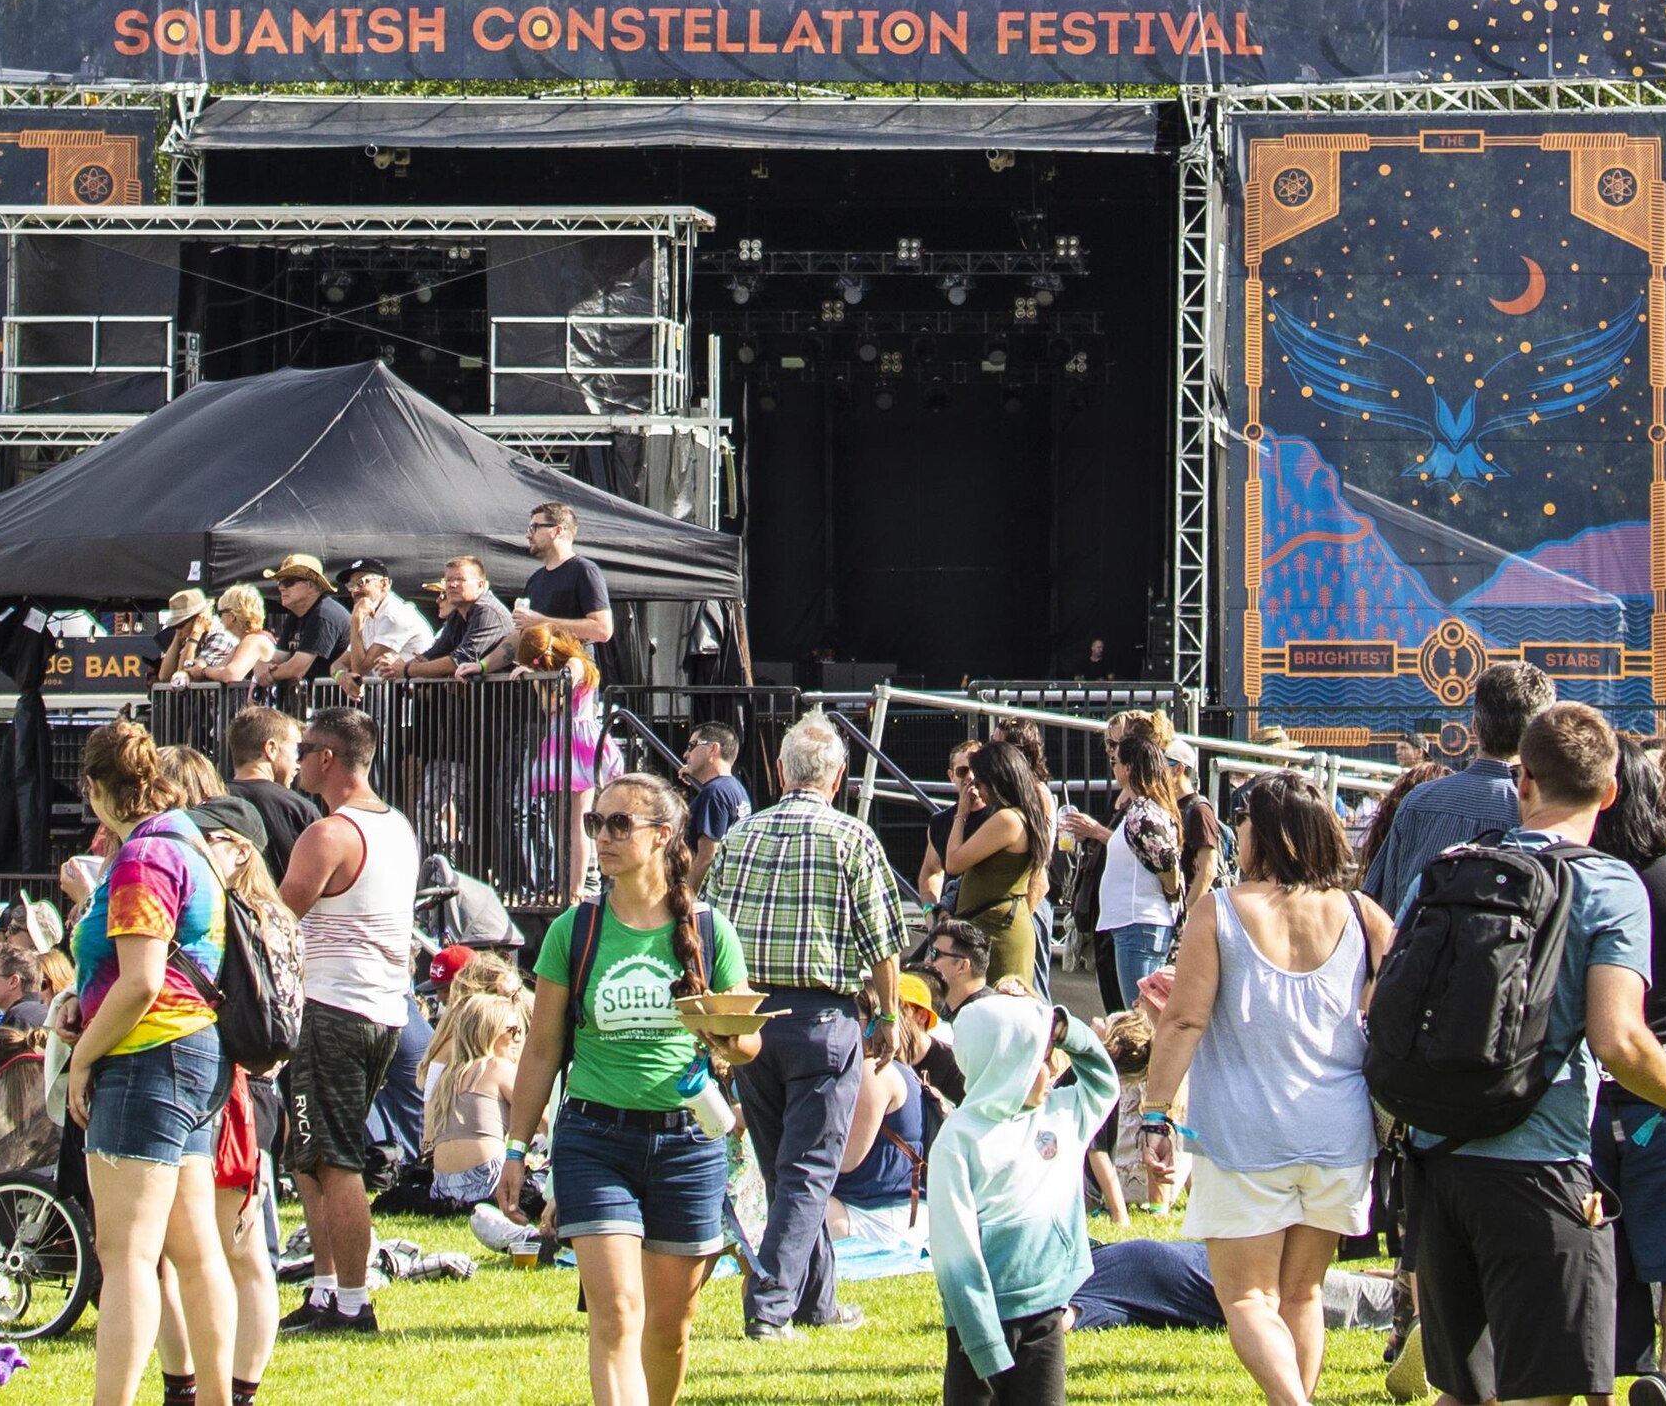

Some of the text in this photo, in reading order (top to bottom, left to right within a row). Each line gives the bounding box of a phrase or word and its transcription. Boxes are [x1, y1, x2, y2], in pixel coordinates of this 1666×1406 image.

[113, 6, 1263, 56] SQUAMISH CONSTELLATION FESTIVAL
[1439, 135, 1466, 147] THE
[85, 655, 141, 678] BAR
[1293, 651, 1390, 665] BRIGHTEST
[1545, 652, 1601, 668] STARS
[295, 1094, 312, 1145] RVCA
